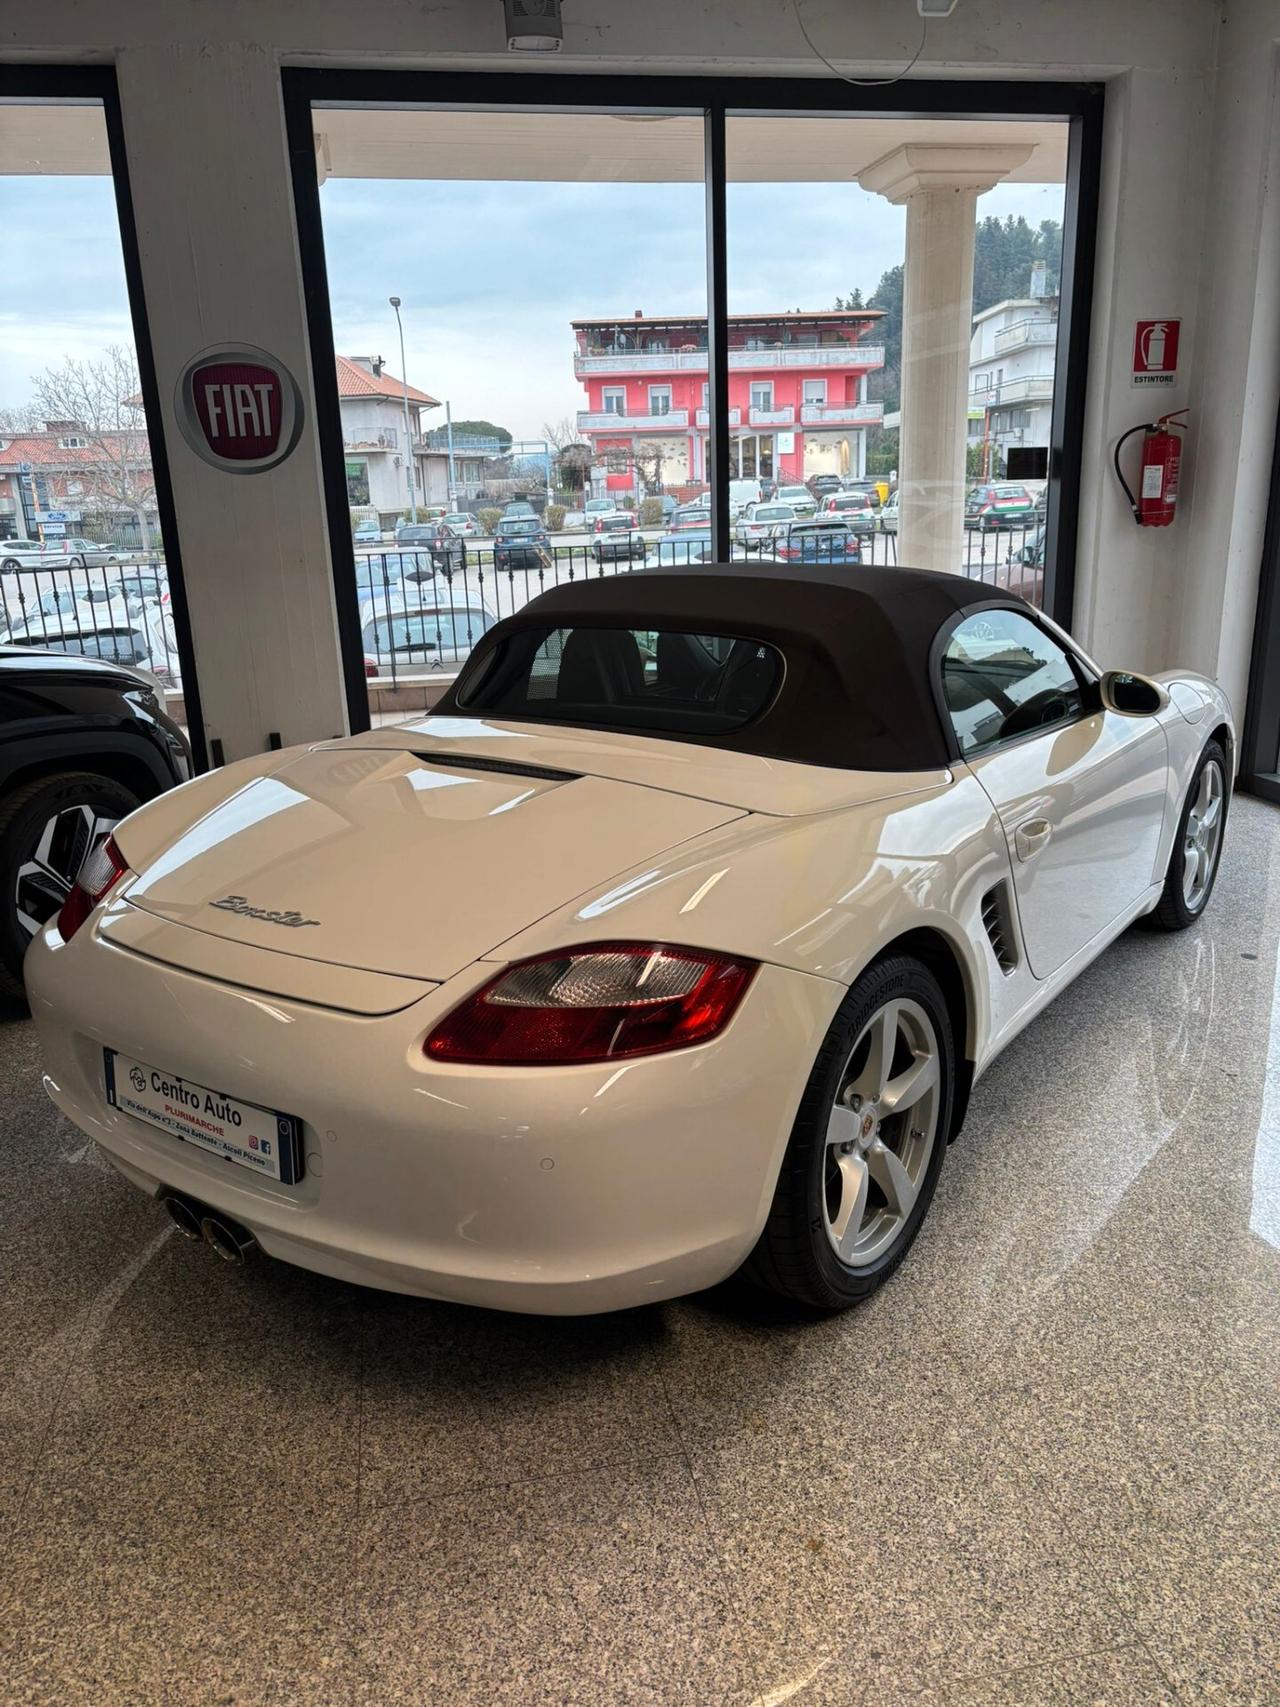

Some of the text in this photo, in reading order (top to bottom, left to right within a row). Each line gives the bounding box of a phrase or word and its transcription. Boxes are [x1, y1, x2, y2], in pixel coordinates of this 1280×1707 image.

[1134, 375, 1174, 384] ESTINTORE
[205, 384, 273, 437] FIAT
[208, 895, 321, 928] Boxster
[151, 1072, 241, 1127] Centro Auto
[165, 1104, 225, 1136] PLURIMARCHE
[176, 1122, 190, 1134] Zona
[223, 1143, 243, 1157] Ascoli
[243, 1152, 266, 1166] Piceno
